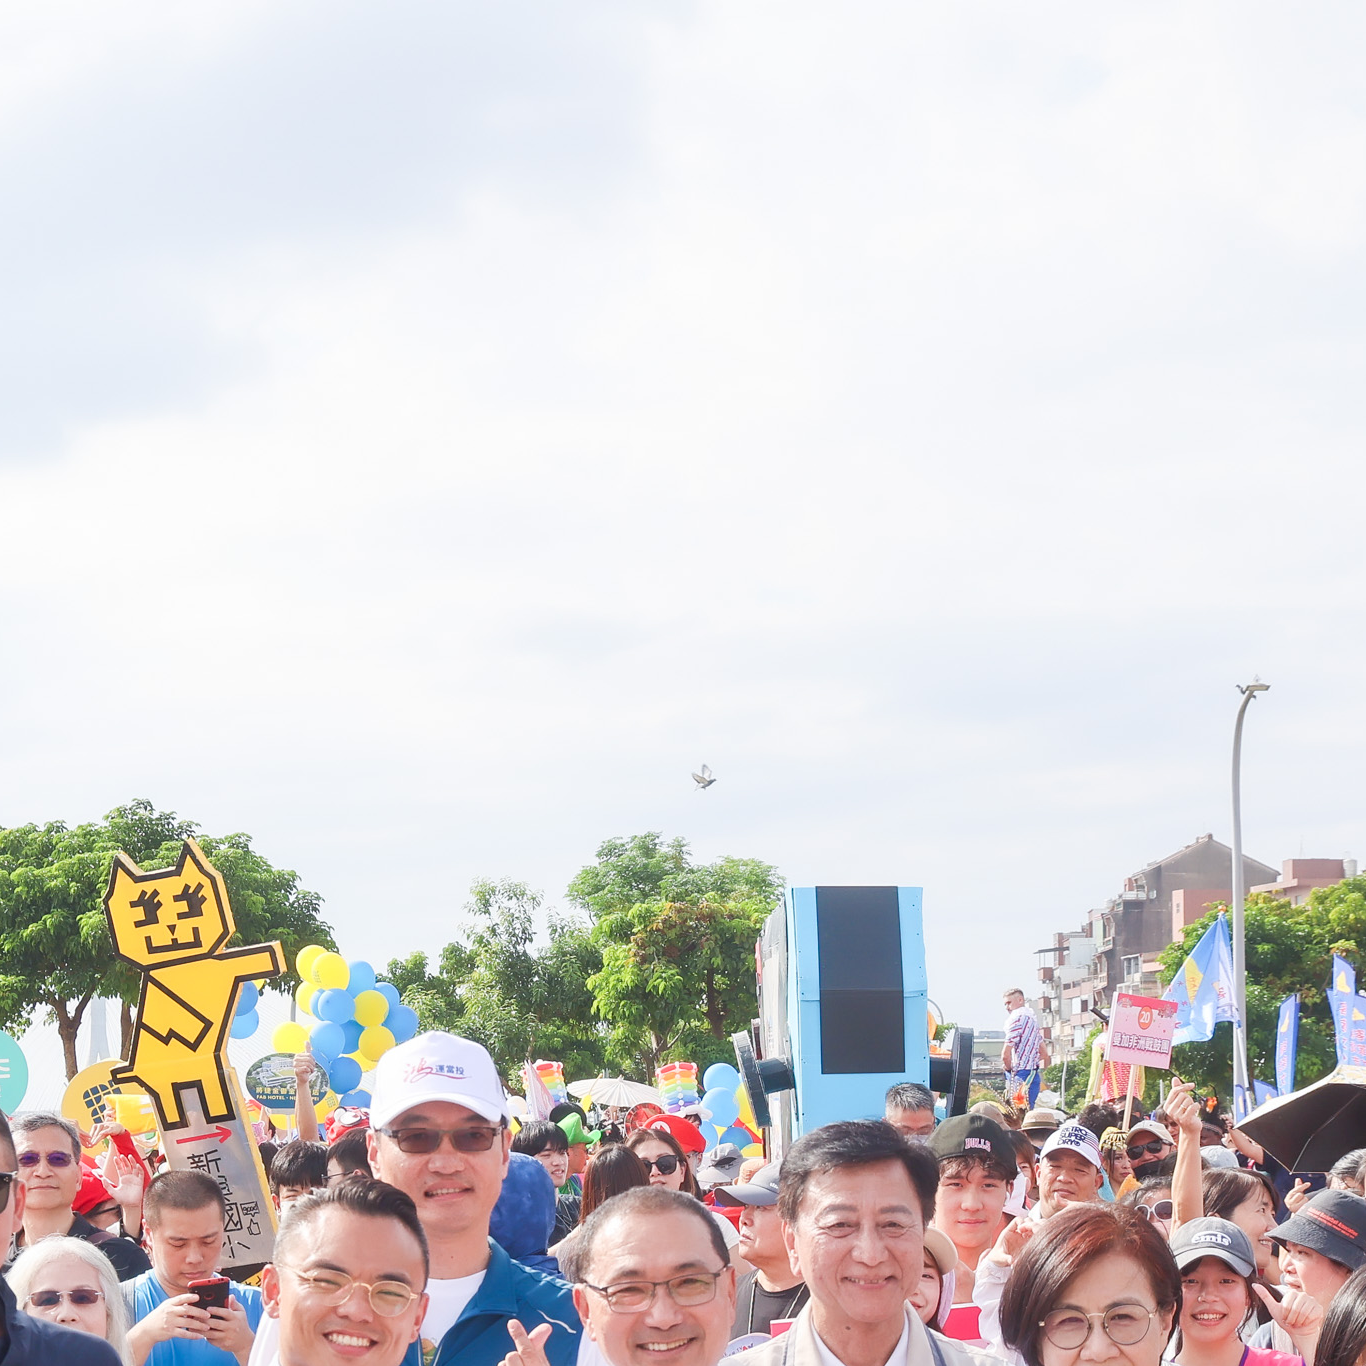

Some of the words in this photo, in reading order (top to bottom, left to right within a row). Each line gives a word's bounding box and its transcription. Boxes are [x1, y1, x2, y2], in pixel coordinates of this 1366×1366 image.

[1139, 1011, 1151, 1023] 20
[965, 1138, 992, 1152] BULLS
[1191, 1231, 1232, 1246] emis
